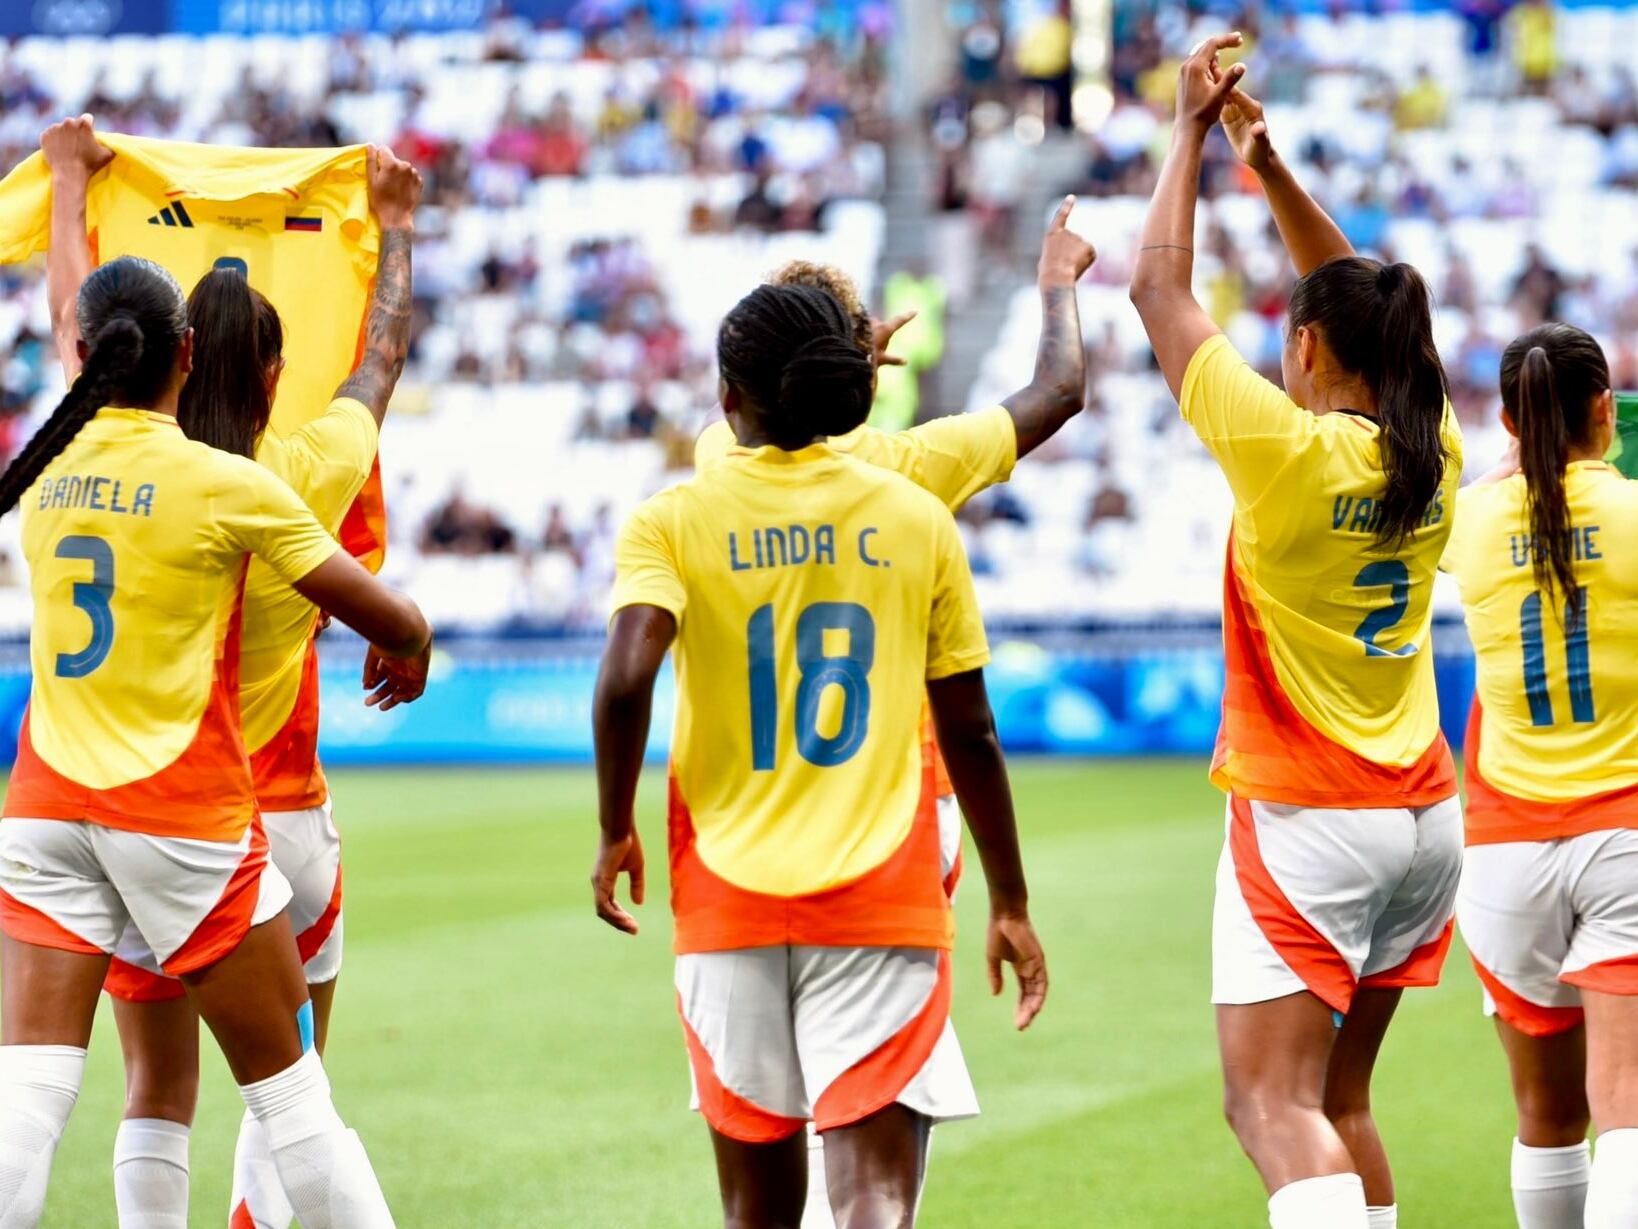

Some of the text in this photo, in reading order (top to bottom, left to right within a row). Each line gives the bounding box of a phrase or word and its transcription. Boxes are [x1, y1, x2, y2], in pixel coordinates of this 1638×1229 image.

[39, 475, 155, 516] DANIELA
[1333, 489, 1444, 533] VAS
[729, 524, 891, 571] LINDA C.
[1511, 526, 1603, 567] UE
[55, 535, 114, 678] 3
[1353, 560, 1418, 657] 2
[747, 602, 875, 771] 18
[1520, 586, 1596, 726] 11
